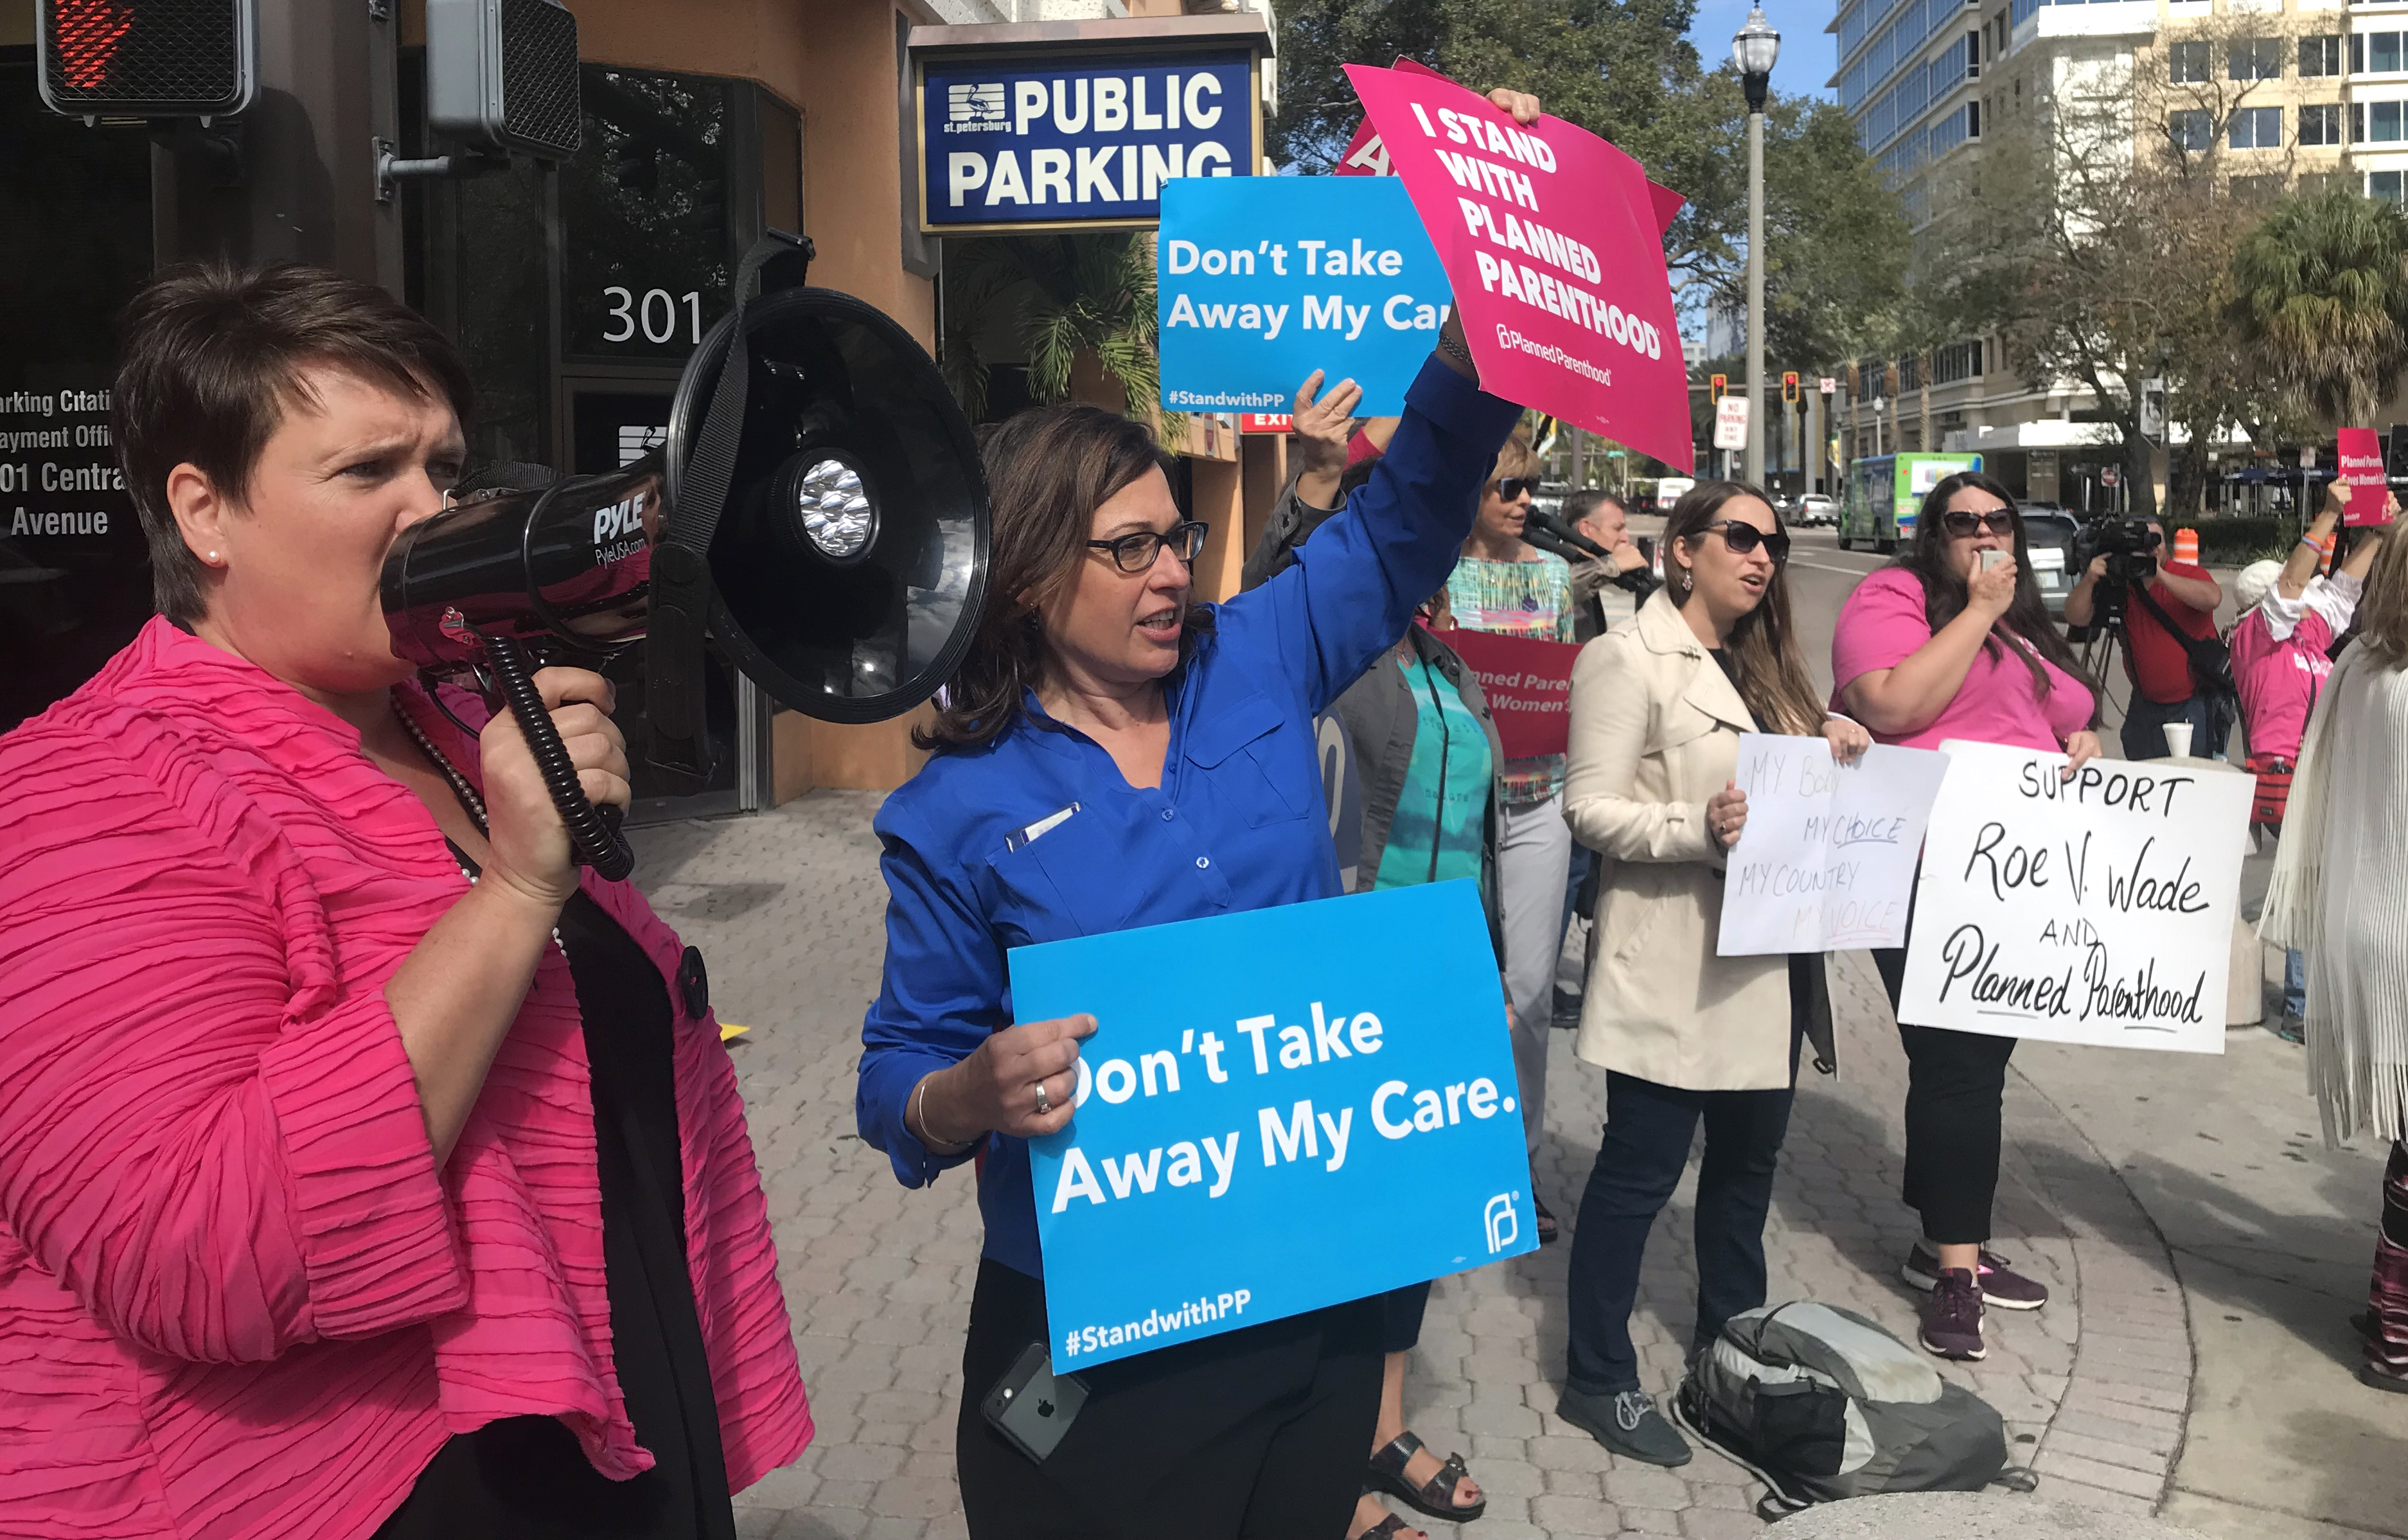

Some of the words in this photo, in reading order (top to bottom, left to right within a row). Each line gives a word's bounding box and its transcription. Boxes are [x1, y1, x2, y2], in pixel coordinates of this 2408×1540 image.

[1015, 72, 1222, 135] PUBLIC
[944, 121, 1011, 134] st.petersburg
[1410, 102, 1437, 137] I
[1437, 107, 1557, 173] STAND
[1434, 148, 1539, 213] WITH
[1169, 240, 1288, 276] Don't
[1297, 238, 1403, 276] Take
[1457, 197, 1602, 285] PLANNED
[603, 286, 700, 344] 301
[1166, 294, 1289, 341] Away
[1303, 295, 1371, 341] My
[1383, 294, 1451, 330] Car
[1474, 249, 1661, 360] PARENTHOOD
[1510, 330, 1557, 364] Planned
[1555, 347, 1611, 387] Parenthood
[0, 391, 53, 417] rking
[60, 389, 110, 412] Citati
[1169, 390, 1285, 407] #StandwithPP
[0, 427, 69, 454] ayment
[75, 425, 113, 447] Offi
[0, 463, 28, 492] 01
[42, 463, 126, 491] Centra
[11, 506, 108, 535] Avenue
[594, 492, 644, 544] PYLE
[595, 537, 646, 569] PyleUSA.com
[1524, 674, 1569, 691] Pare
[1749, 751, 1787, 797] MY
[2019, 756, 2195, 818] SUPPORT
[1803, 816, 1830, 842] MY
[1832, 812, 1907, 846] CHOICE
[1739, 863, 1772, 896] MY
[1773, 860, 1861, 897] COUNTRY
[1964, 822, 2049, 901] Roe
[2108, 836, 2210, 913] Wade
[1830, 899, 1899, 937] VOICE
[2039, 917, 2098, 947] AND
[1939, 924, 2072, 1018] Planned
[2078, 943, 2208, 1023] Parenthood
[1237, 1002, 1383, 1075] Take
[1051, 1131, 1239, 1214] Away
[1258, 1099, 1353, 1173] My
[1370, 1075, 1516, 1140] Care.
[1065, 1289, 1252, 1358] #StandwithPP
